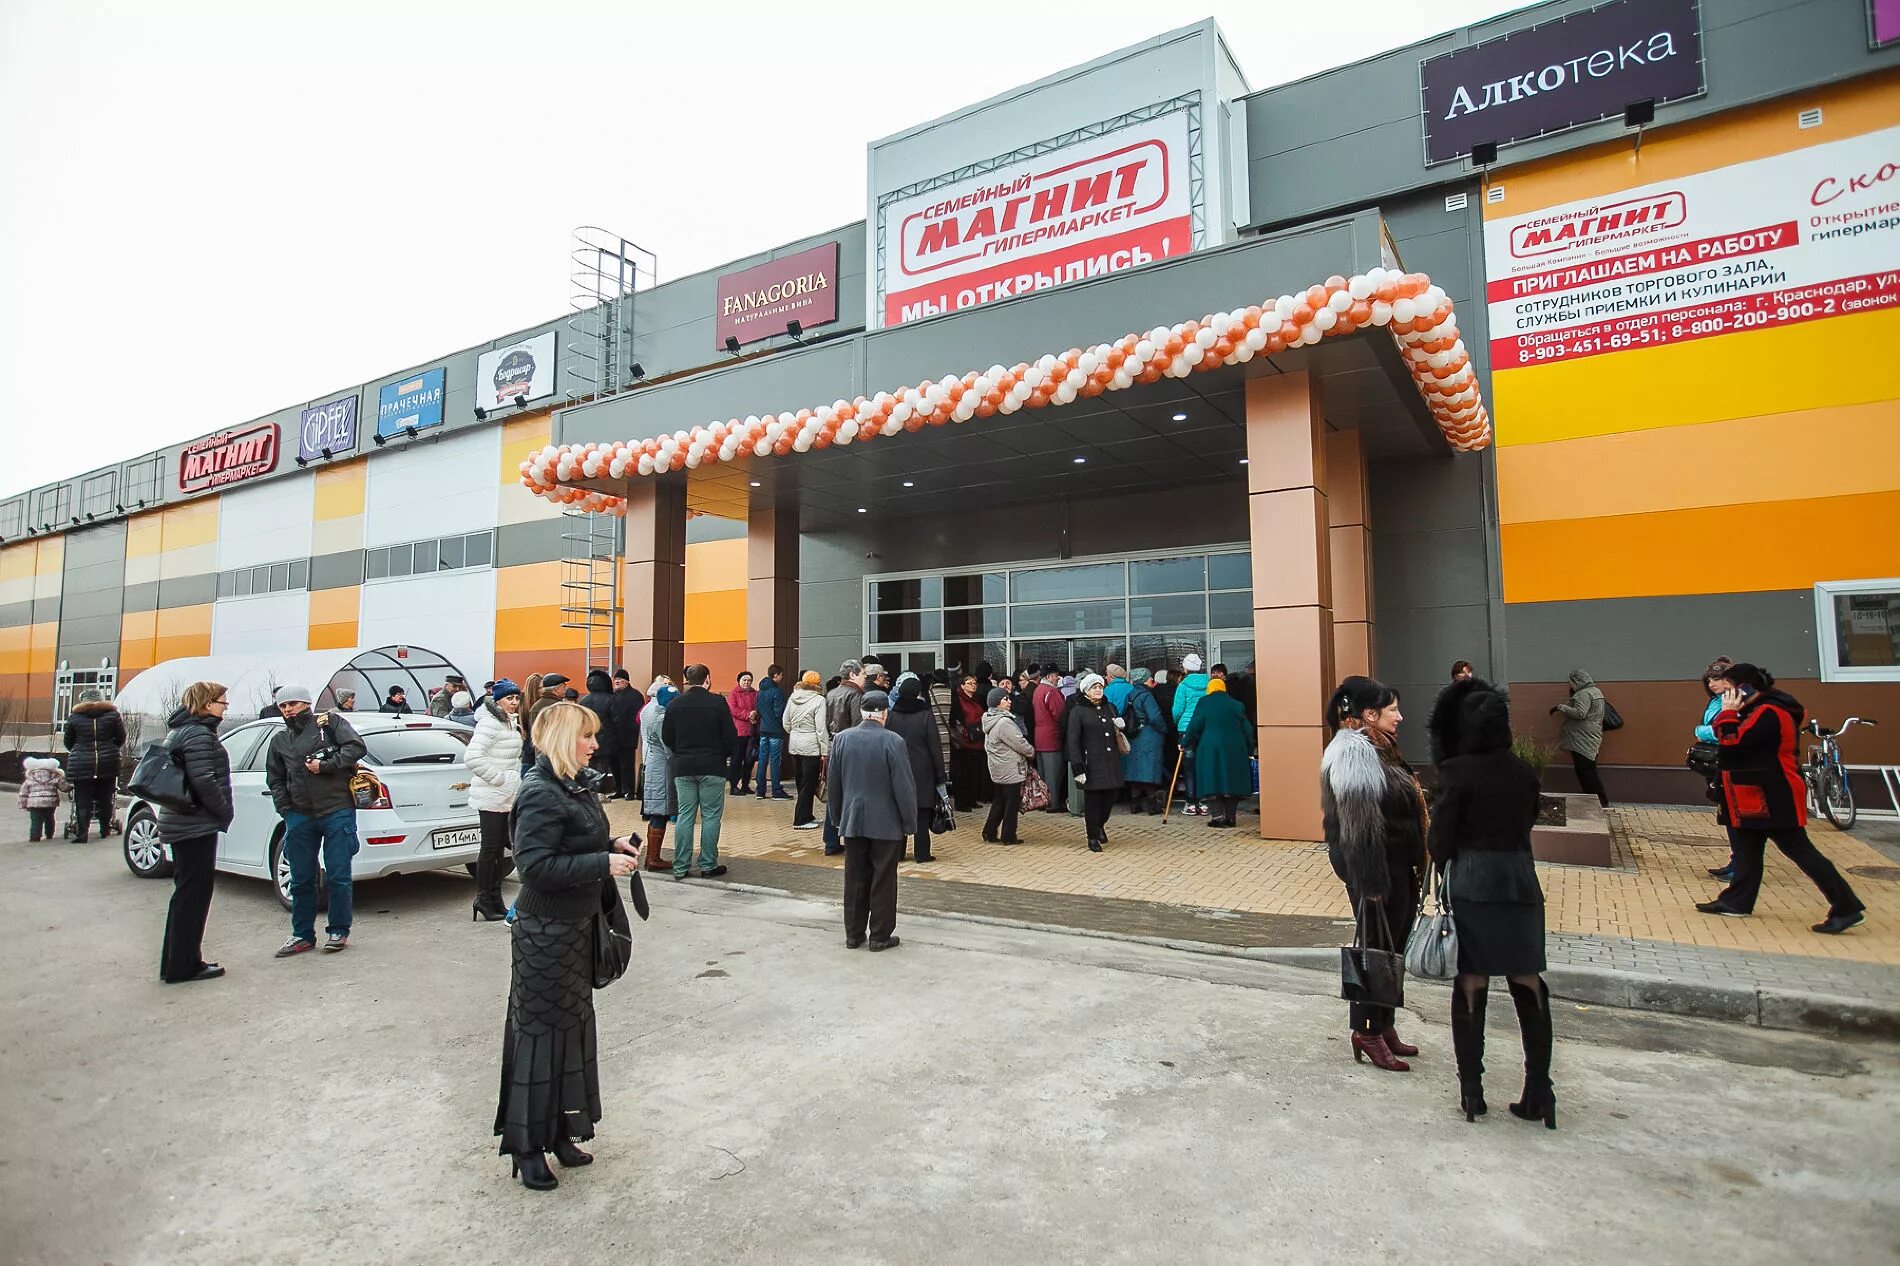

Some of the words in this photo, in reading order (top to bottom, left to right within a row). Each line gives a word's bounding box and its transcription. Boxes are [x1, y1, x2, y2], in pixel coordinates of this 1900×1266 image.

[1444, 32, 1676, 120] Алкотека
[916, 158, 1148, 256] МАГНИТ
[923, 172, 1032, 220] СЕМЕЙНЫЙ
[1525, 205, 1600, 229] СЕМЕЙНЫЙ
[1810, 202, 1900, 227] Открытие
[982, 201, 1138, 257] ГИПЕРМАРКЕТ
[1522, 200, 1672, 249] МАГНИТ
[1568, 222, 1667, 250] ГИПЕРМАРКЕТ
[1511, 262, 1546, 273] Большая
[1547, 253, 1586, 265] Компания
[1594, 244, 1631, 256] Большие
[1633, 232, 1689, 249] возможности
[1513, 254, 1656, 295] ПРИГЛАШАЕМ
[1661, 247, 1692, 267] НА
[1697, 228, 1783, 259] РАБОТУ
[723, 271, 828, 317] FANAGORIA
[901, 294, 948, 323] МЫ
[956, 245, 1153, 310] ОТКРЫЛИСЬ
[1515, 287, 1622, 315] СОТРУДНИКОВ
[1625, 268, 1717, 295] ТОРГОВОГО
[1722, 258, 1774, 277] ЗАЛА,
[1516, 309, 1581, 329] СЛУЖБЫ
[1585, 294, 1661, 317] ПРИЕМКИ
[1665, 291, 1676, 303] И
[1682, 271, 1786, 299] КУЛИНАРИИ
[734, 304, 789, 325] НАТУРАЛЬНЫЕ
[791, 297, 813, 310] ВИНА
[1517, 325, 1600, 348] Обращаться
[1604, 323, 1612, 332] в
[1616, 316, 1658, 331] отдел
[1661, 301, 1747, 323] персонала:
[1756, 297, 1768, 308] г.
[1773, 278, 1872, 305] Краснодар,
[1519, 329, 1667, 363] 8-903-451-69-51;
[1671, 299, 1835, 337] 8-800-200-900-2
[1841, 293, 1897, 312] (звонок
[381, 387, 440, 416] ПРАЧЕЧНАЯ
[183, 434, 268, 481] МАГНИТ
